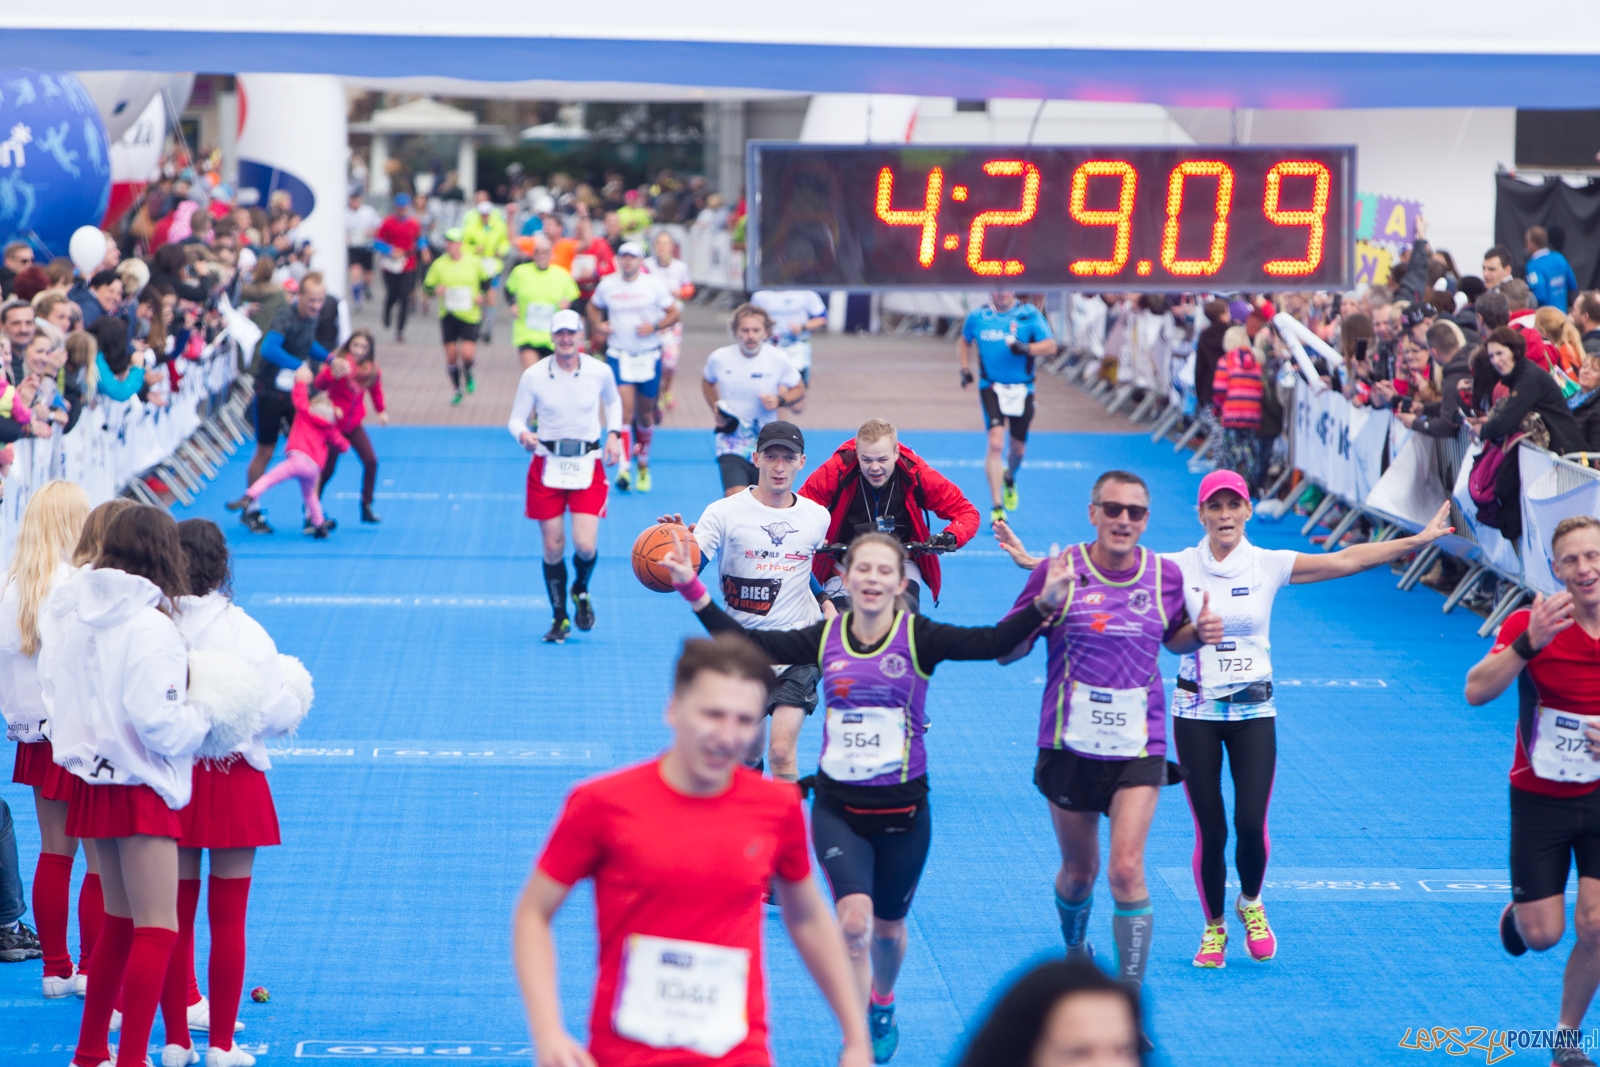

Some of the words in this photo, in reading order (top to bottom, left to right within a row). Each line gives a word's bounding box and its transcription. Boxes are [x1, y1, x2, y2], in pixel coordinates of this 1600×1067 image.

[740, 585, 770, 600] BIEG
[1217, 657, 1254, 673] 1732
[1091, 709, 1127, 727] 555
[842, 732, 881, 748] 564
[1126, 917, 1148, 976] Kalenji
